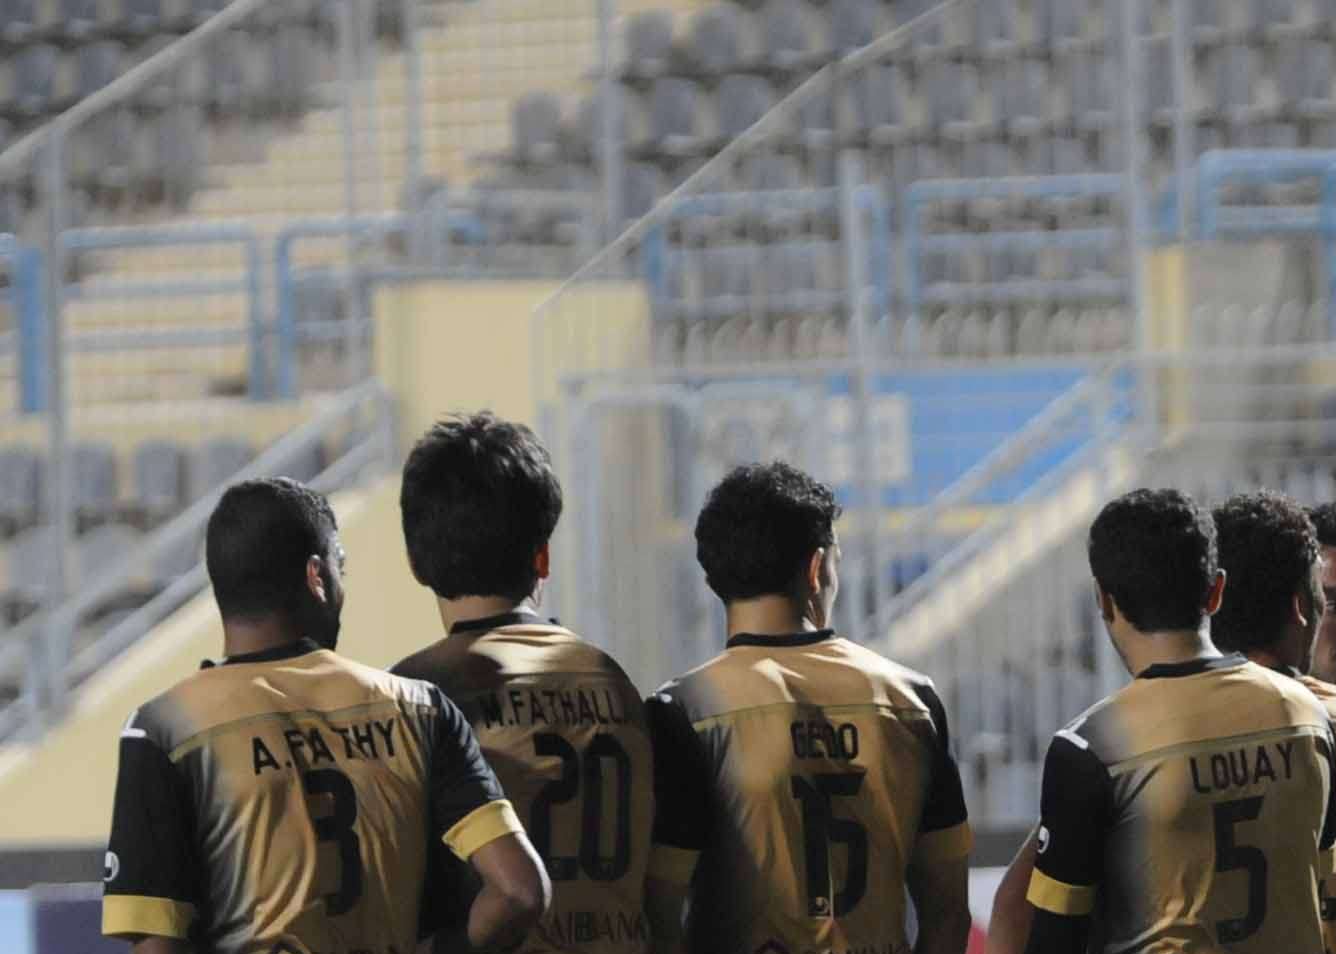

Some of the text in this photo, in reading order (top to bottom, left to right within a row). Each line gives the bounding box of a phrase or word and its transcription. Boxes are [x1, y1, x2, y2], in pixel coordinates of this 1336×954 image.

[529, 732, 630, 880] 20
[1189, 742, 1294, 794] LOUAY
[303, 768, 361, 917] 3
[1212, 796, 1267, 945] 5
